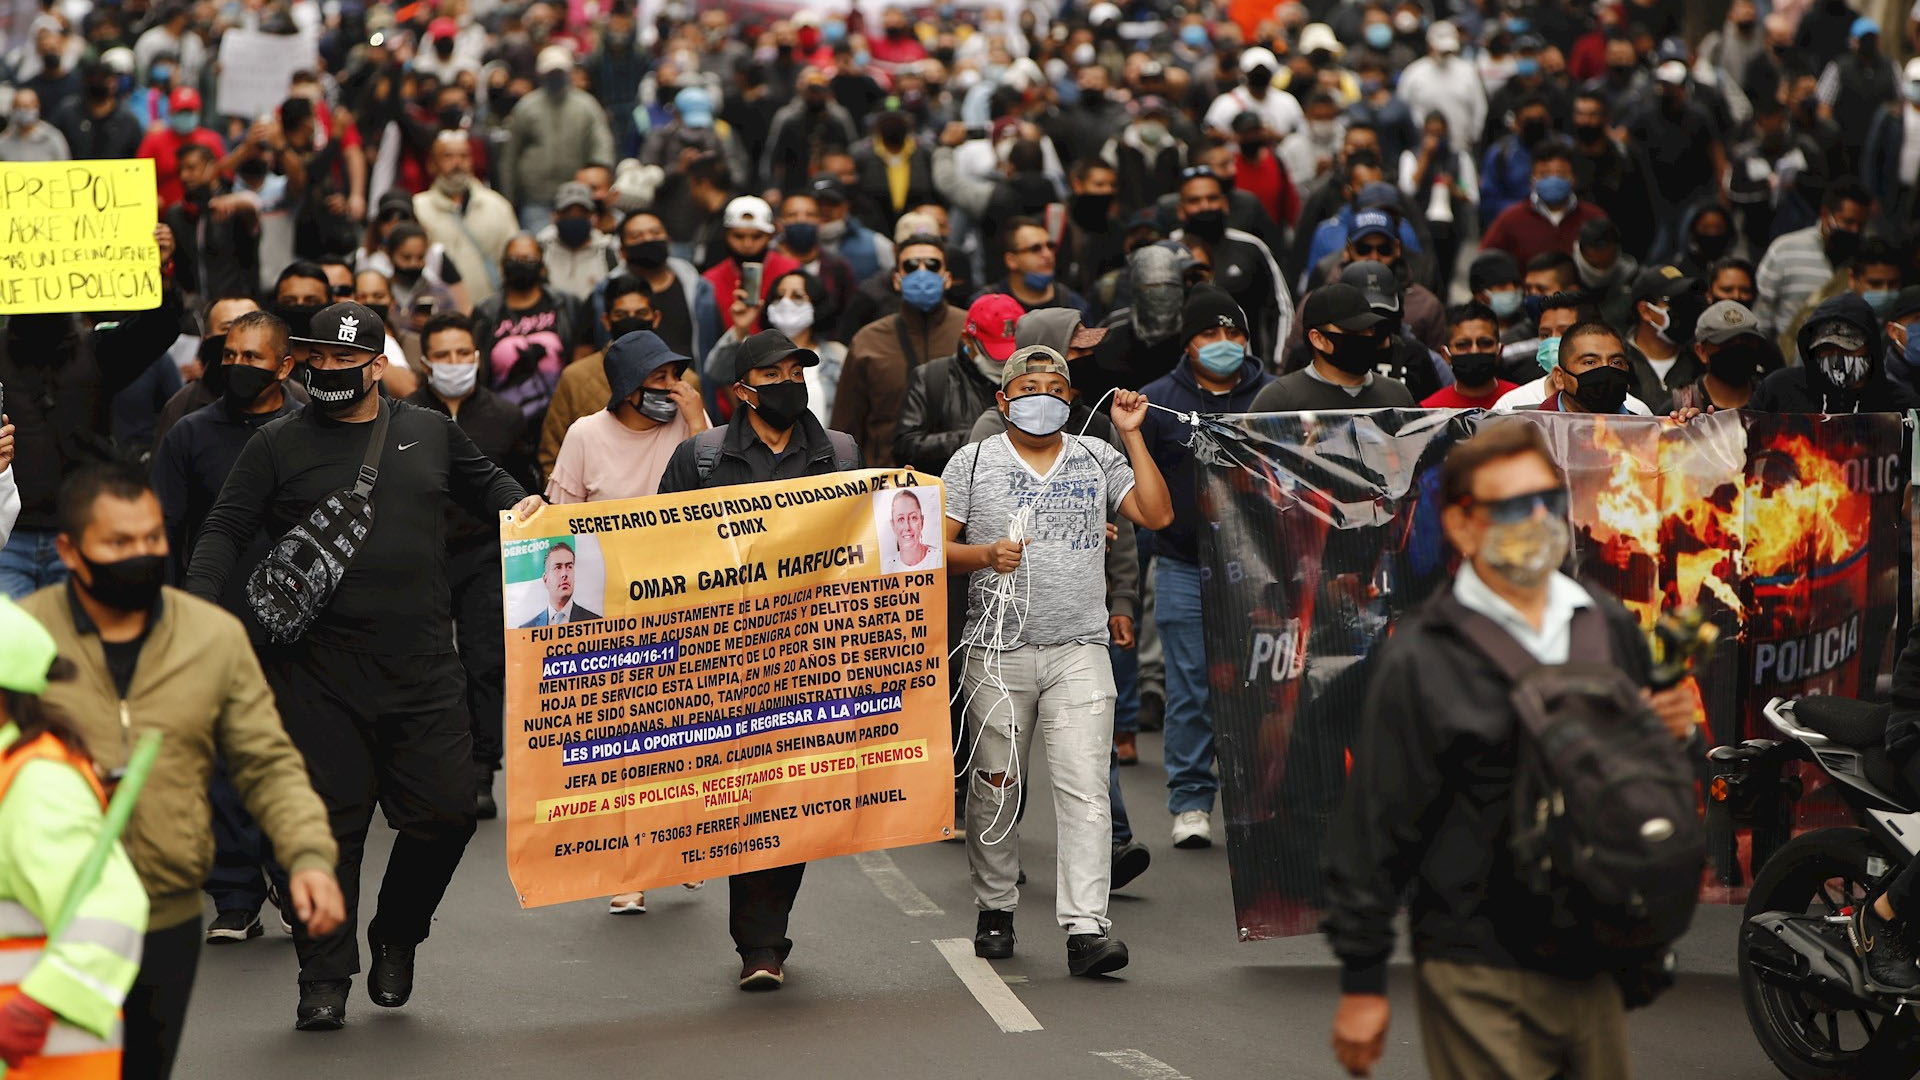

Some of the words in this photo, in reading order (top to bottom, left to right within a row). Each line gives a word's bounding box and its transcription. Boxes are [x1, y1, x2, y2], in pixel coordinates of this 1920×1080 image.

[8, 215, 62, 244] ABRE
[30, 249, 55, 268] UN
[29, 275, 62, 303] TU
[568, 510, 657, 534] SECRETARIO
[660, 508, 681, 524] DE
[682, 496, 772, 521] SEGURIDAD
[774, 480, 868, 508] CIUDADANA
[871, 475, 888, 491] DE
[894, 472, 918, 487] LA
[717, 518, 767, 539] CDMX
[504, 540, 550, 558] DERECHOS
[630, 575, 686, 600] OMAR
[698, 562, 768, 590] GARCIA
[778, 544, 864, 578] HARFUCH
[532, 628, 553, 642] FUI
[558, 618, 637, 639] DESTITUIDO
[642, 604, 734, 629] INJUSTAMENTE
[739, 602, 751, 614] DE
[755, 598, 770, 612] LA
[774, 589, 812, 608] POLICIA
[816, 577, 900, 598] PREVENTIVA
[905, 574, 934, 587] POR
[546, 644, 572, 658] CCC
[577, 636, 635, 653] QUIENES
[639, 632, 656, 645] ME
[661, 625, 709, 642] ACUSAN
[714, 622, 729, 634] DE
[734, 609, 797, 632] CONDUCTAS
[801, 606, 807, 618] Y
[811, 598, 868, 617] DELITOS
[874, 591, 920, 609] SEGÚN
[539, 674, 605, 694] MENTIRAS
[611, 671, 624, 684] DE
[629, 668, 654, 681] SER
[658, 664, 675, 677] UN
[679, 654, 744, 674] ELEMENTO
[747, 651, 759, 664] DE
[763, 648, 775, 661] LO
[779, 641, 808, 657] PEOR
[813, 637, 835, 651] SIN
[841, 629, 907, 647] PRUEBAS,
[911, 626, 927, 639] MI
[543, 661, 577, 677] ACTA
[581, 646, 674, 672] CCC/1640/16-11
[679, 641, 720, 658] DONDE
[725, 637, 744, 650] ME
[745, 627, 790, 647] DENIGRA
[794, 622, 819, 636] CON
[824, 617, 852, 631] UNA
[858, 612, 900, 628] SARTA
[906, 609, 924, 622] DE
[1754, 615, 1858, 686] POLICIA
[524, 714, 572, 732] NUNCA
[576, 711, 592, 725] HE
[597, 706, 624, 721] SIDO
[629, 693, 714, 716] SANCIONADO,
[718, 682, 770, 703] TAMPOCO
[774, 679, 787, 692] HE
[792, 671, 840, 688] TENIDO
[848, 660, 922, 681] DENUNCIAS
[926, 657, 940, 669] NI
[541, 696, 576, 712] HOJA
[581, 693, 597, 706] DE
[601, 684, 657, 704] SERVICIO
[662, 679, 693, 693] ESTA
[697, 670, 742, 689] LIMPIA,
[746, 668, 759, 681] EN
[763, 664, 780, 678] MIS
[784, 659, 796, 672] 20
[799, 653, 836, 670] AÑOS
[842, 652, 859, 664] DE
[864, 643, 925, 661] SERVICIO
[528, 731, 581, 749] QUEJAS
[672, 714, 684, 727] NI
[688, 706, 742, 724] PENALES
[745, 702, 756, 716] NI
[881, 679, 906, 692] POR
[910, 674, 936, 688] ESO
[563, 747, 588, 762] LES
[592, 742, 621, 759] PIDO
[624, 739, 640, 753] LA
[644, 724, 732, 749] OPORTUNIDAD
[736, 722, 747, 735] DE
[750, 708, 813, 731] REGRESAR
[817, 707, 827, 720] A
[831, 704, 850, 718] LA
[854, 696, 901, 716] POLICIA
[547, 800, 597, 821] ¡AYUDE
[601, 799, 610, 810] A
[614, 793, 635, 809] SUS
[639, 784, 699, 804] POLICIAS,
[702, 767, 783, 793] NECESITAMOS
[788, 764, 806, 777] DE
[861, 746, 923, 766] TENEMOS
[564, 774, 596, 789] JEFA
[601, 771, 617, 784] DE
[621, 760, 684, 780] GOBIERNO
[696, 754, 722, 769] DRA.
[726, 743, 772, 763] CLAUDIA
[776, 731, 856, 753] SHEINBAUM
[859, 723, 899, 741] PARDO
[554, 836, 629, 856] EX-POLICIA
[650, 825, 692, 844] 763063
[696, 816, 739, 835] FERRER
[743, 806, 797, 827] JIMENEZ
[802, 799, 851, 816] VICTOR
[855, 789, 907, 809] MANUEL
[682, 849, 705, 864] TEL:
[709, 836, 780, 859] 5516019653
